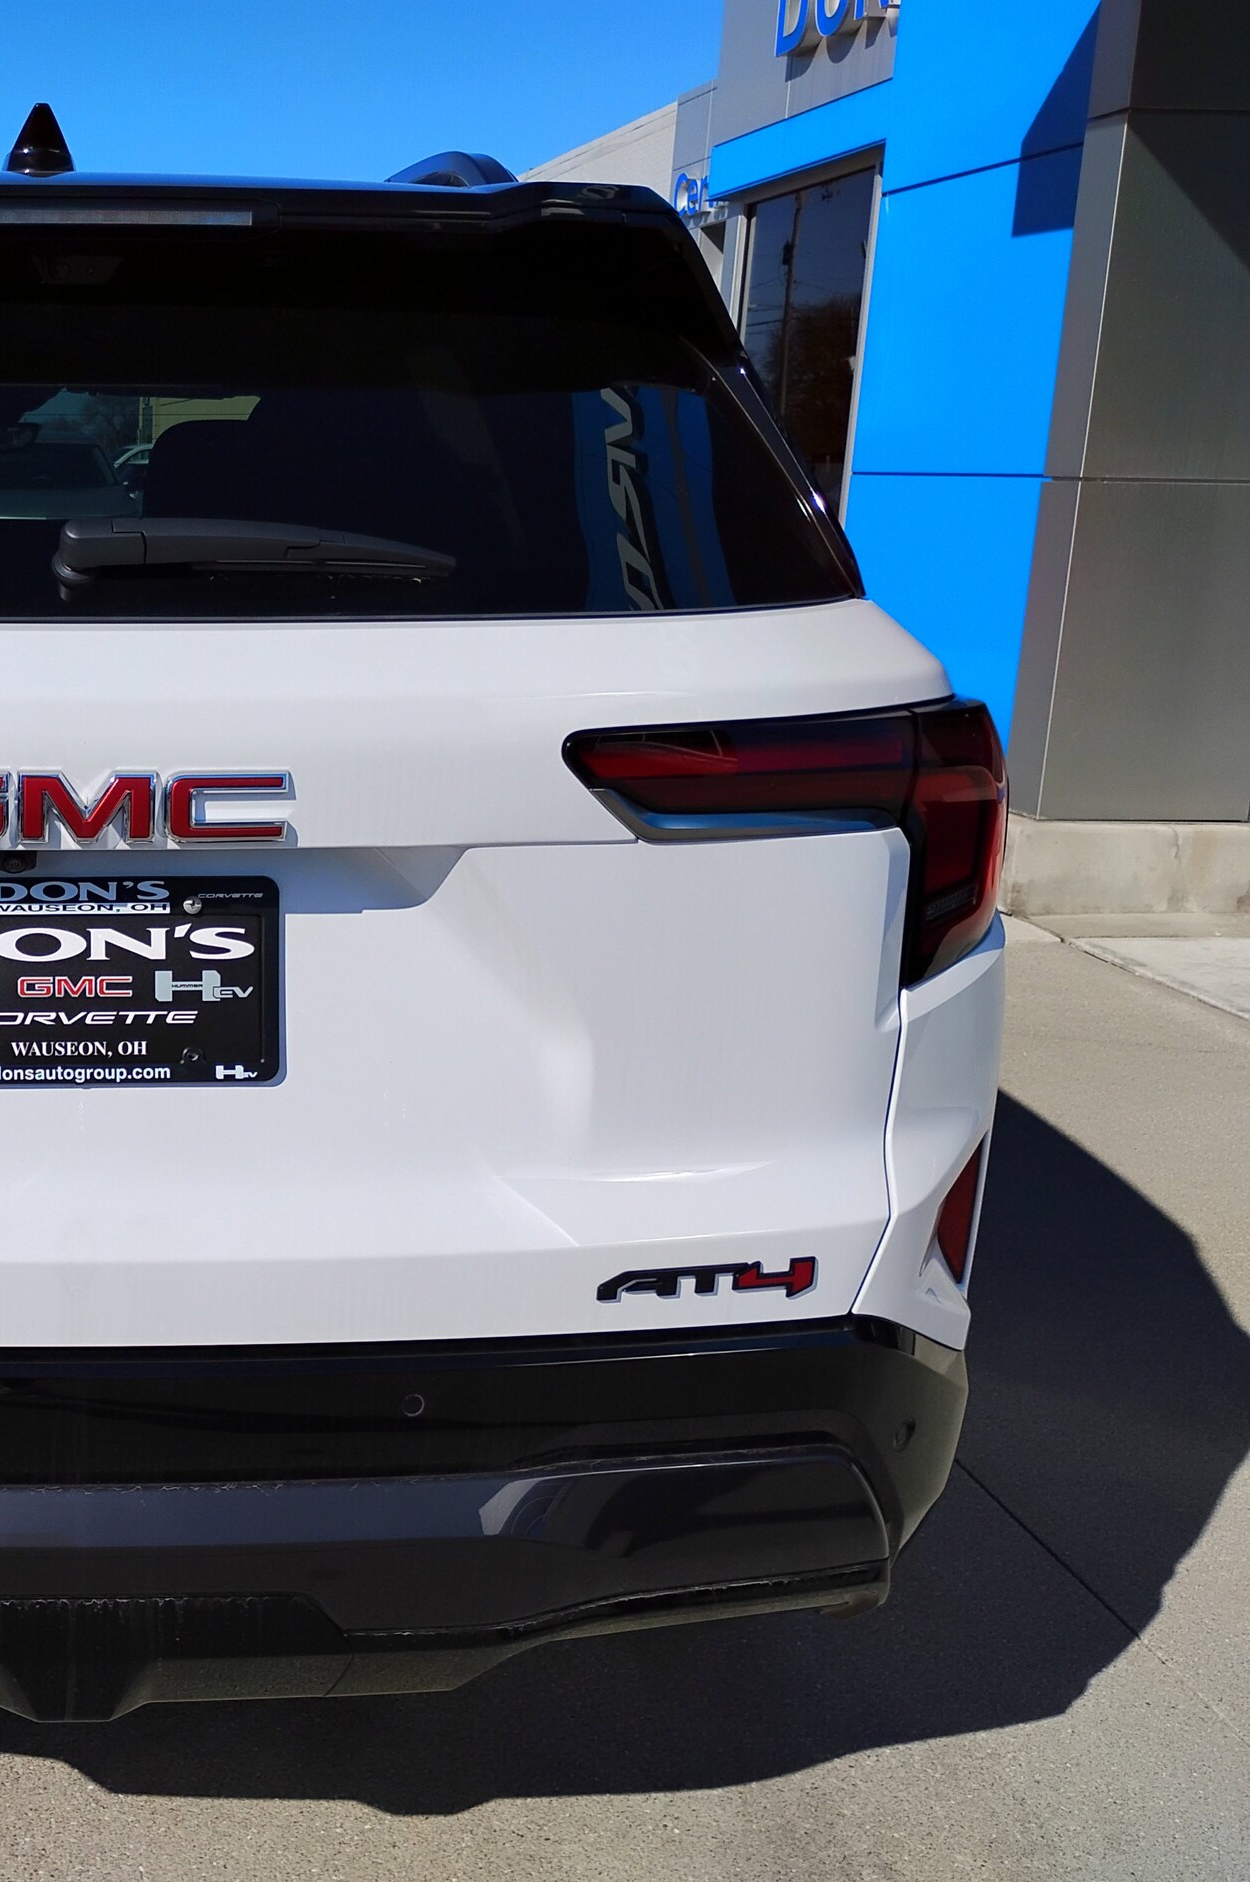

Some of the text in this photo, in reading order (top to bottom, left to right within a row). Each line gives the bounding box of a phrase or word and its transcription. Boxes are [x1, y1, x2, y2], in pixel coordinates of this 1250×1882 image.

[130, 903, 168, 912] OH
[17, 975, 134, 999] GMC
[10, 1041, 148, 1059] WAUSEON, OH
[595, 1255, 819, 1304] AT4
